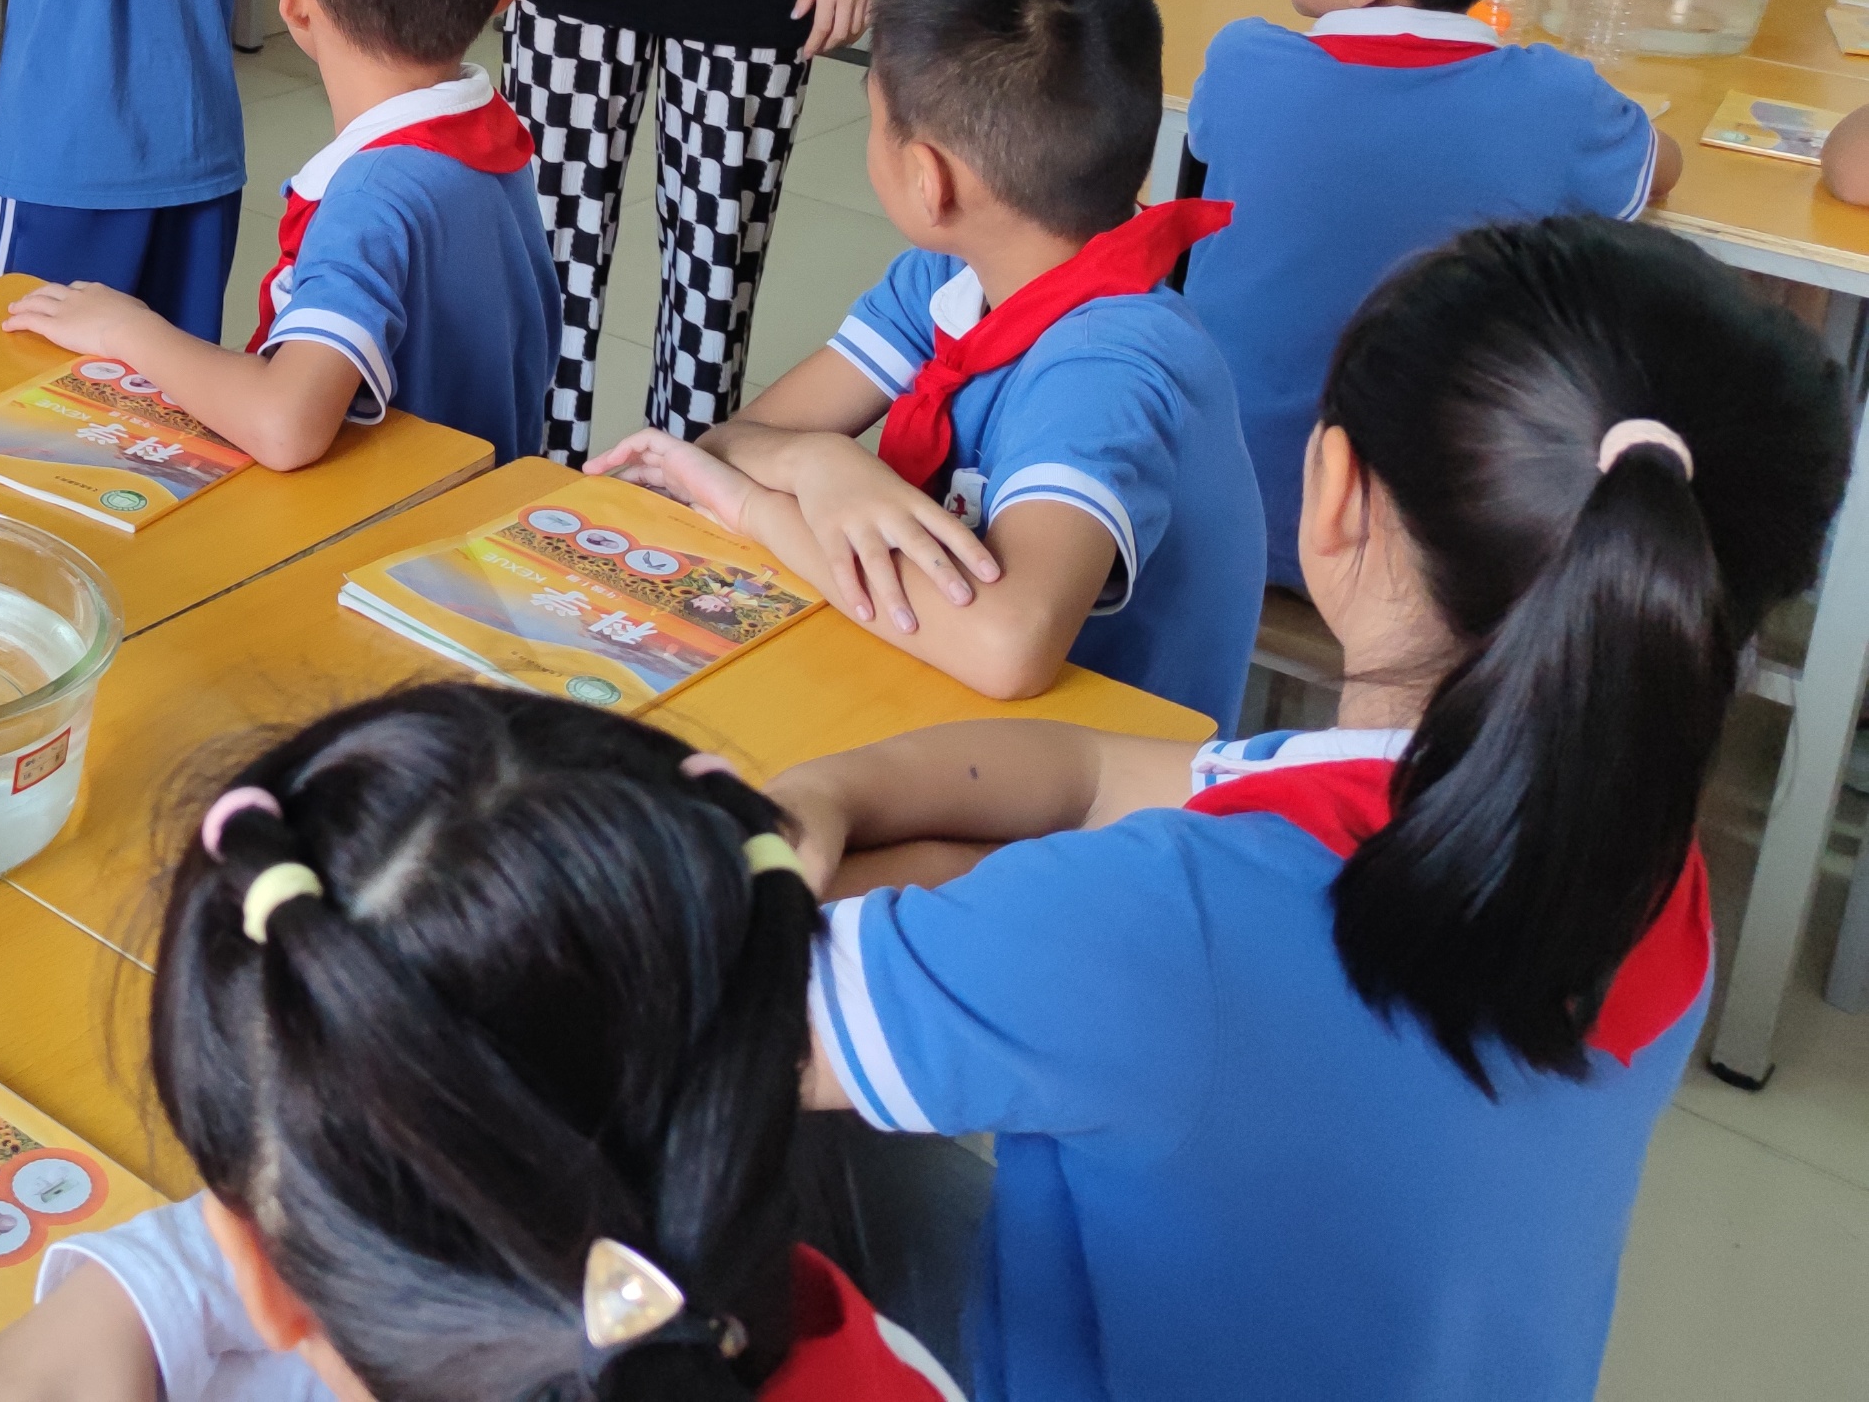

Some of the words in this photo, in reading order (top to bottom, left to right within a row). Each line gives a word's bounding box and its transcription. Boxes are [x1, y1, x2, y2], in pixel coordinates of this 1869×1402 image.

[75, 421, 185, 464] 科学
[479, 552, 548, 584] KEXUE
[530, 586, 658, 646] 科学
